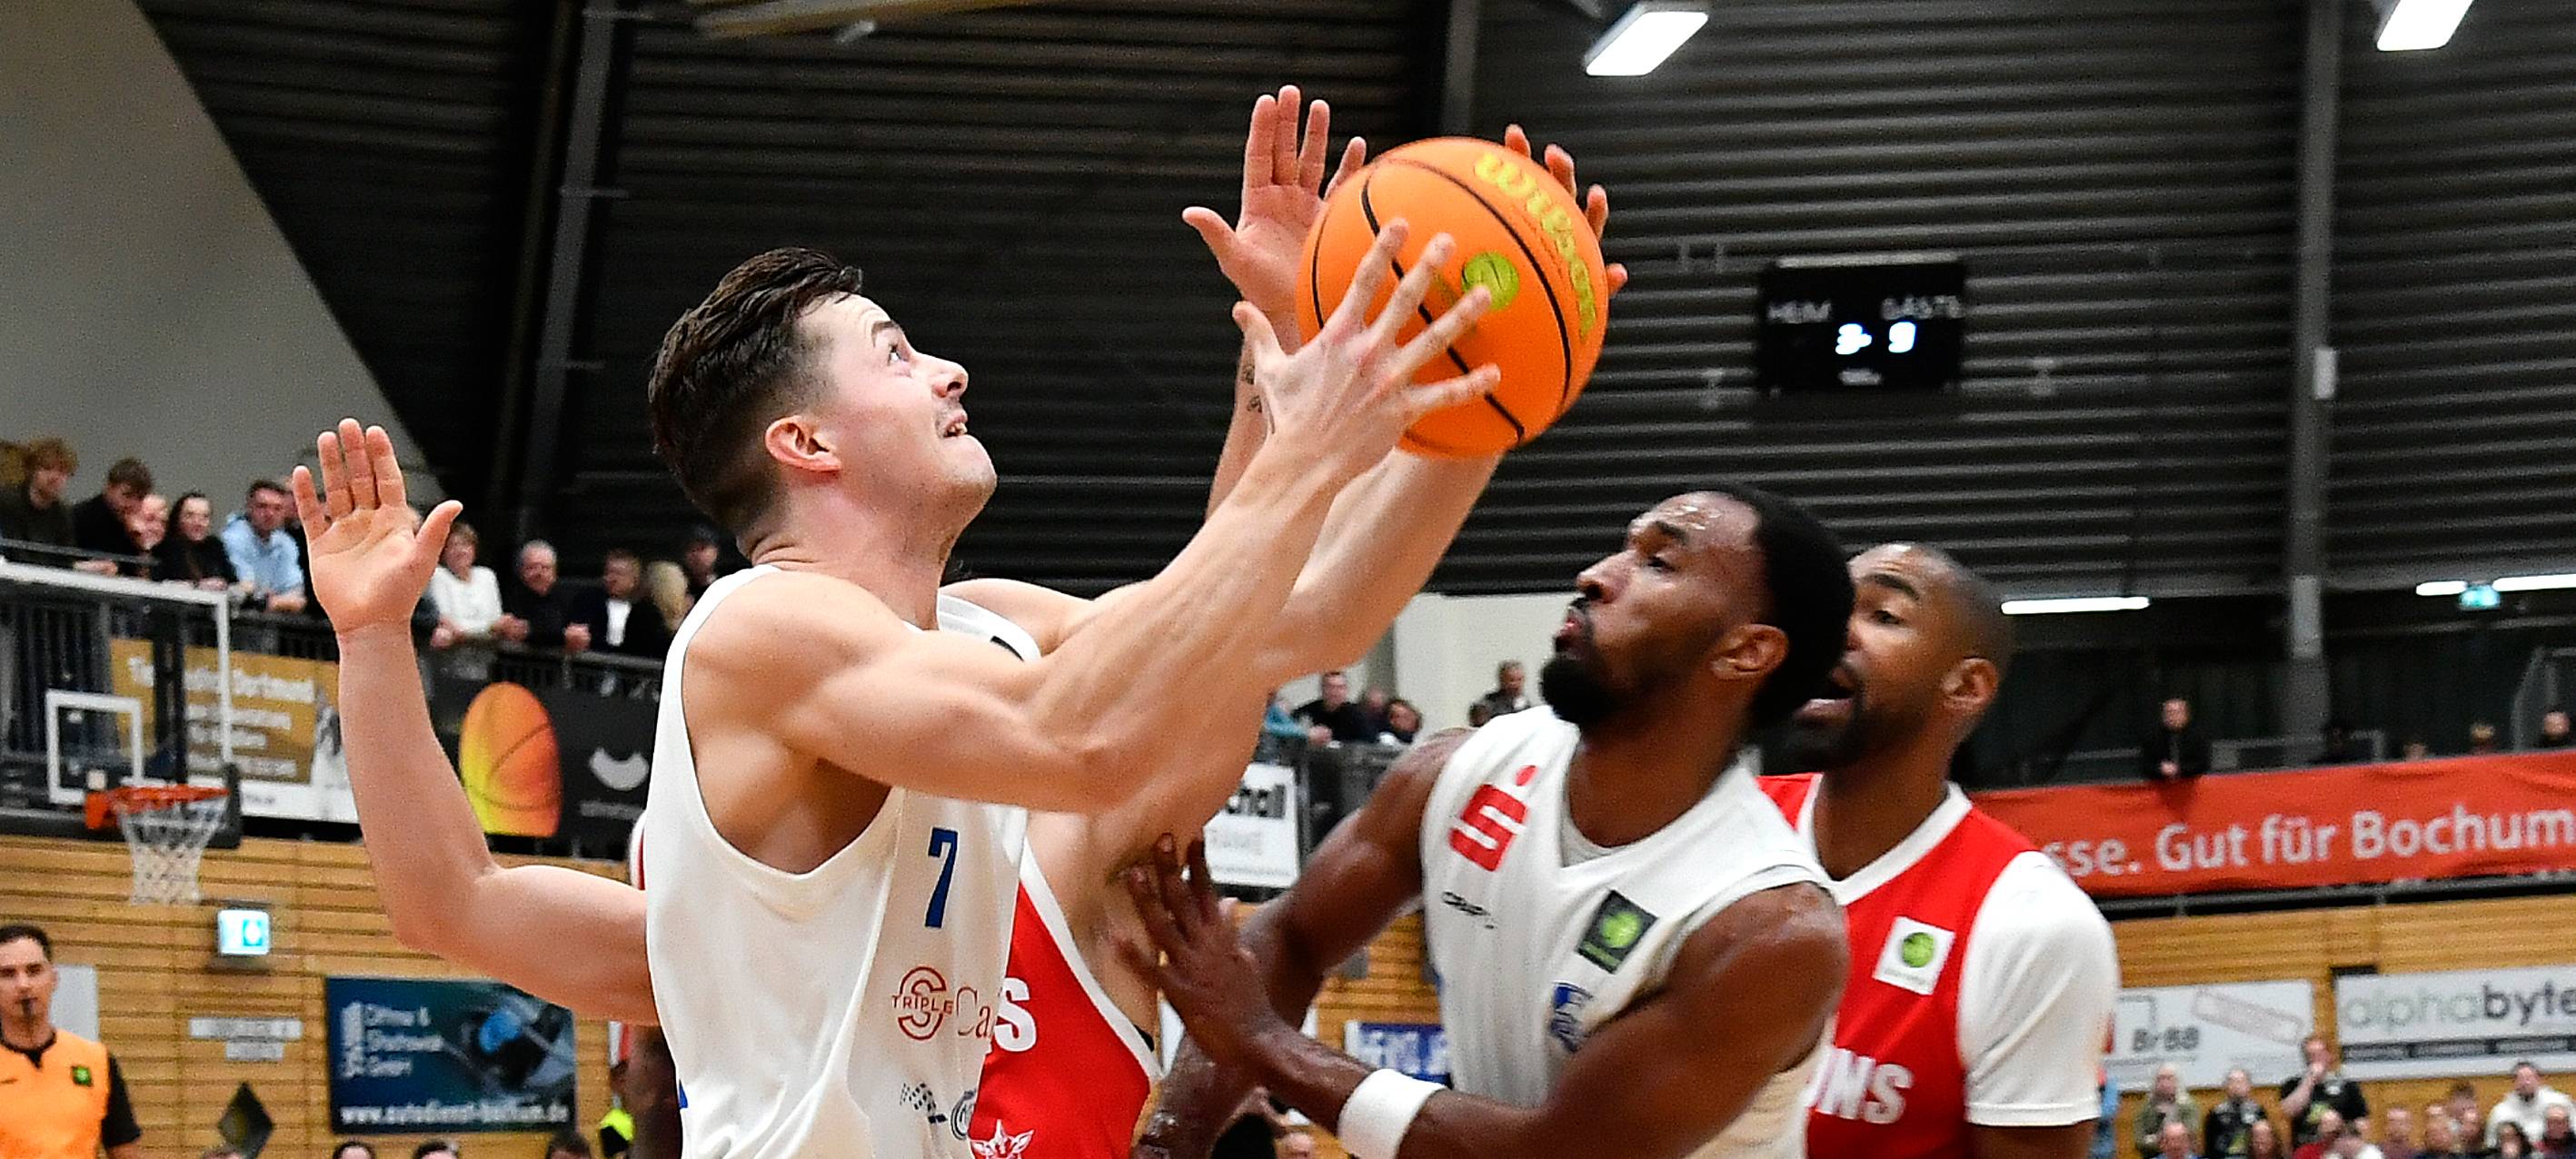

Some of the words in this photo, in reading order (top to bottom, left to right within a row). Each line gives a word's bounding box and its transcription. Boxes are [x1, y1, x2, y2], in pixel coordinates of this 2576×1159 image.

[1473, 152, 1597, 343] Wilson
[924, 827, 960, 929] 7
[2155, 822, 2249, 871] Gut
[2261, 813, 2337, 864] für
[2352, 804, 2576, 859] Bochum
[891, 995, 954, 1015] TRIPLE
[956, 986, 996, 1039] Ca
